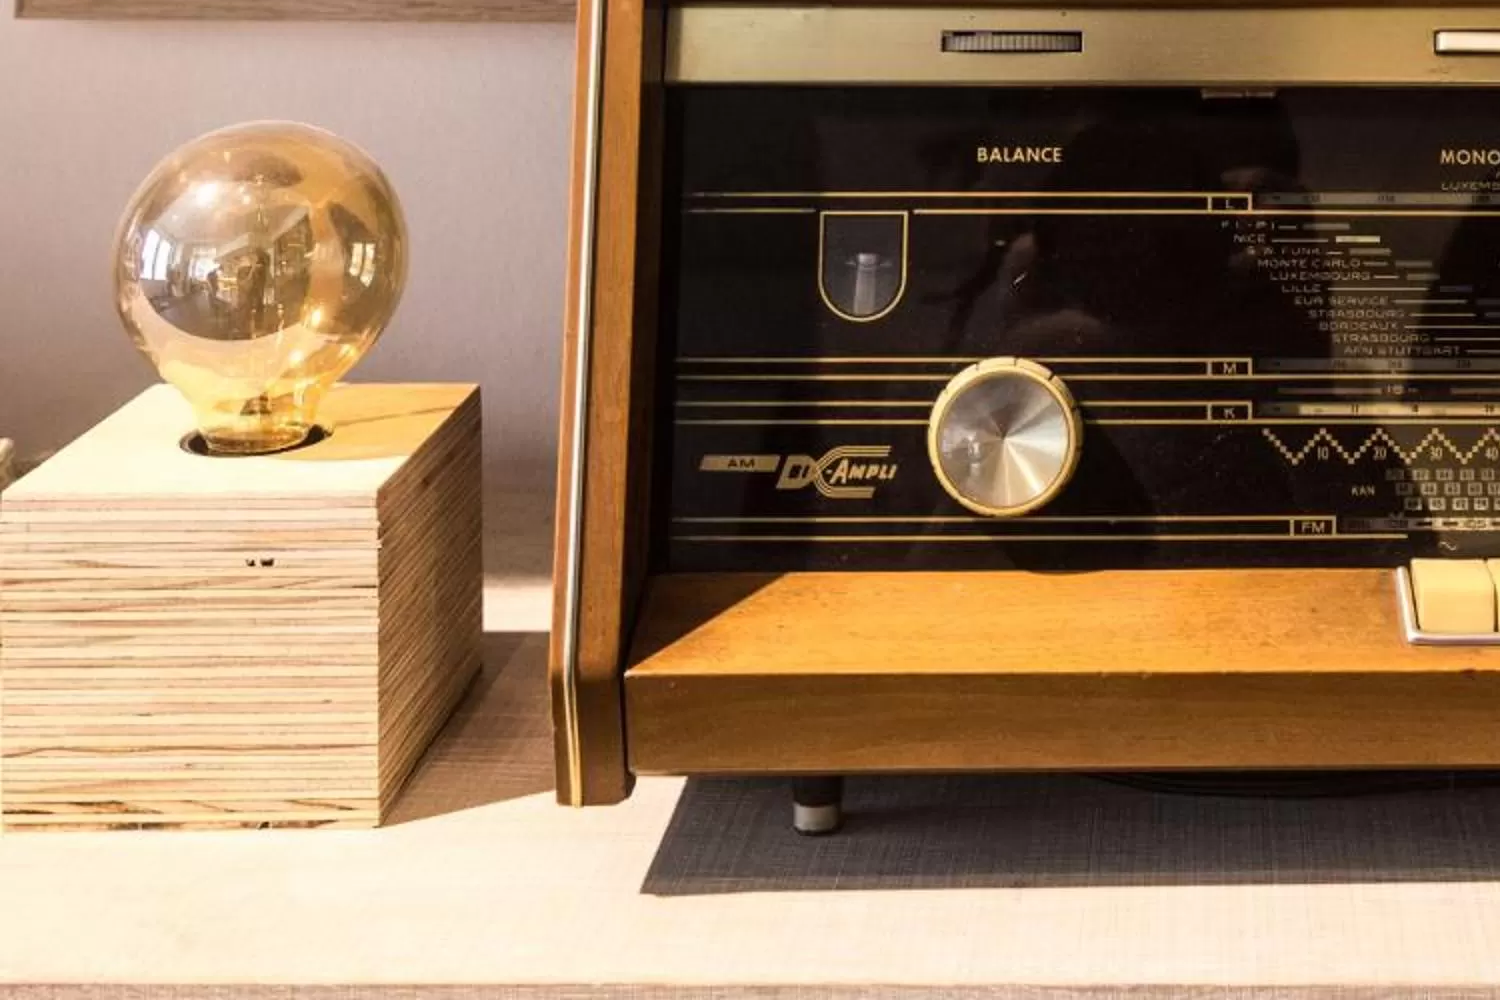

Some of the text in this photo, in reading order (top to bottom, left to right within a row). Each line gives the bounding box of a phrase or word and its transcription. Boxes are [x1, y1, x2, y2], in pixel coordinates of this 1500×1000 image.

[976, 146, 1063, 163] BALANCE
[1222, 363, 1237, 374] M
[1317, 447, 1329, 460] 10
[1373, 447, 1387, 460] 20
[1429, 447, 1443, 460] 30
[1485, 447, 1499, 460] 40
[1351, 485, 1376, 497] KAN
[1301, 520, 1326, 534] FM
